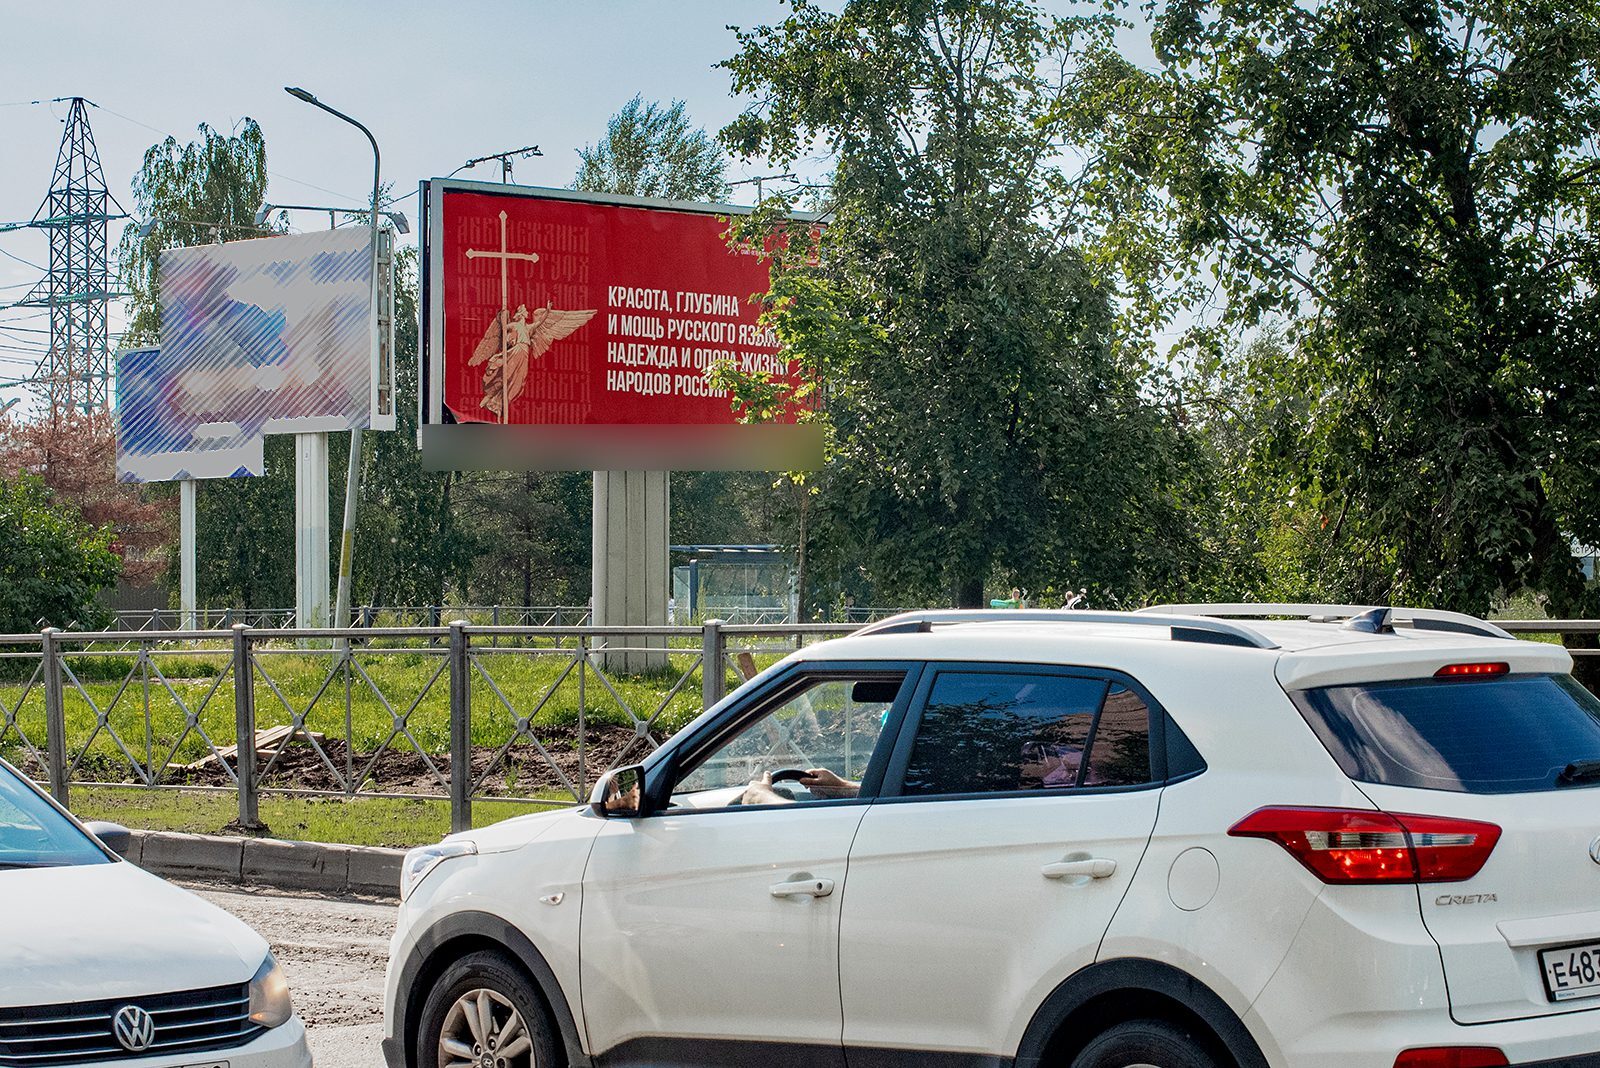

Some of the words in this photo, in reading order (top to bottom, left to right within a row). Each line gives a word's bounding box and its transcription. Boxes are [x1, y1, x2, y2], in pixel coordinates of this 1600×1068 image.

[608, 286, 673, 314] КРАСОТА,
[676, 291, 739, 317] ГЛУБИНА
[608, 314, 617, 335] И
[621, 315, 664, 341] МОЩЬ
[667, 319, 735, 344] РУССКОГО
[738, 324, 782, 349] ЯЗЫК
[608, 342, 677, 370] НАДЕЖДА
[681, 348, 691, 368] И
[607, 370, 671, 396] НАРОДОВ
[1435, 893, 1498, 906] CRETA
